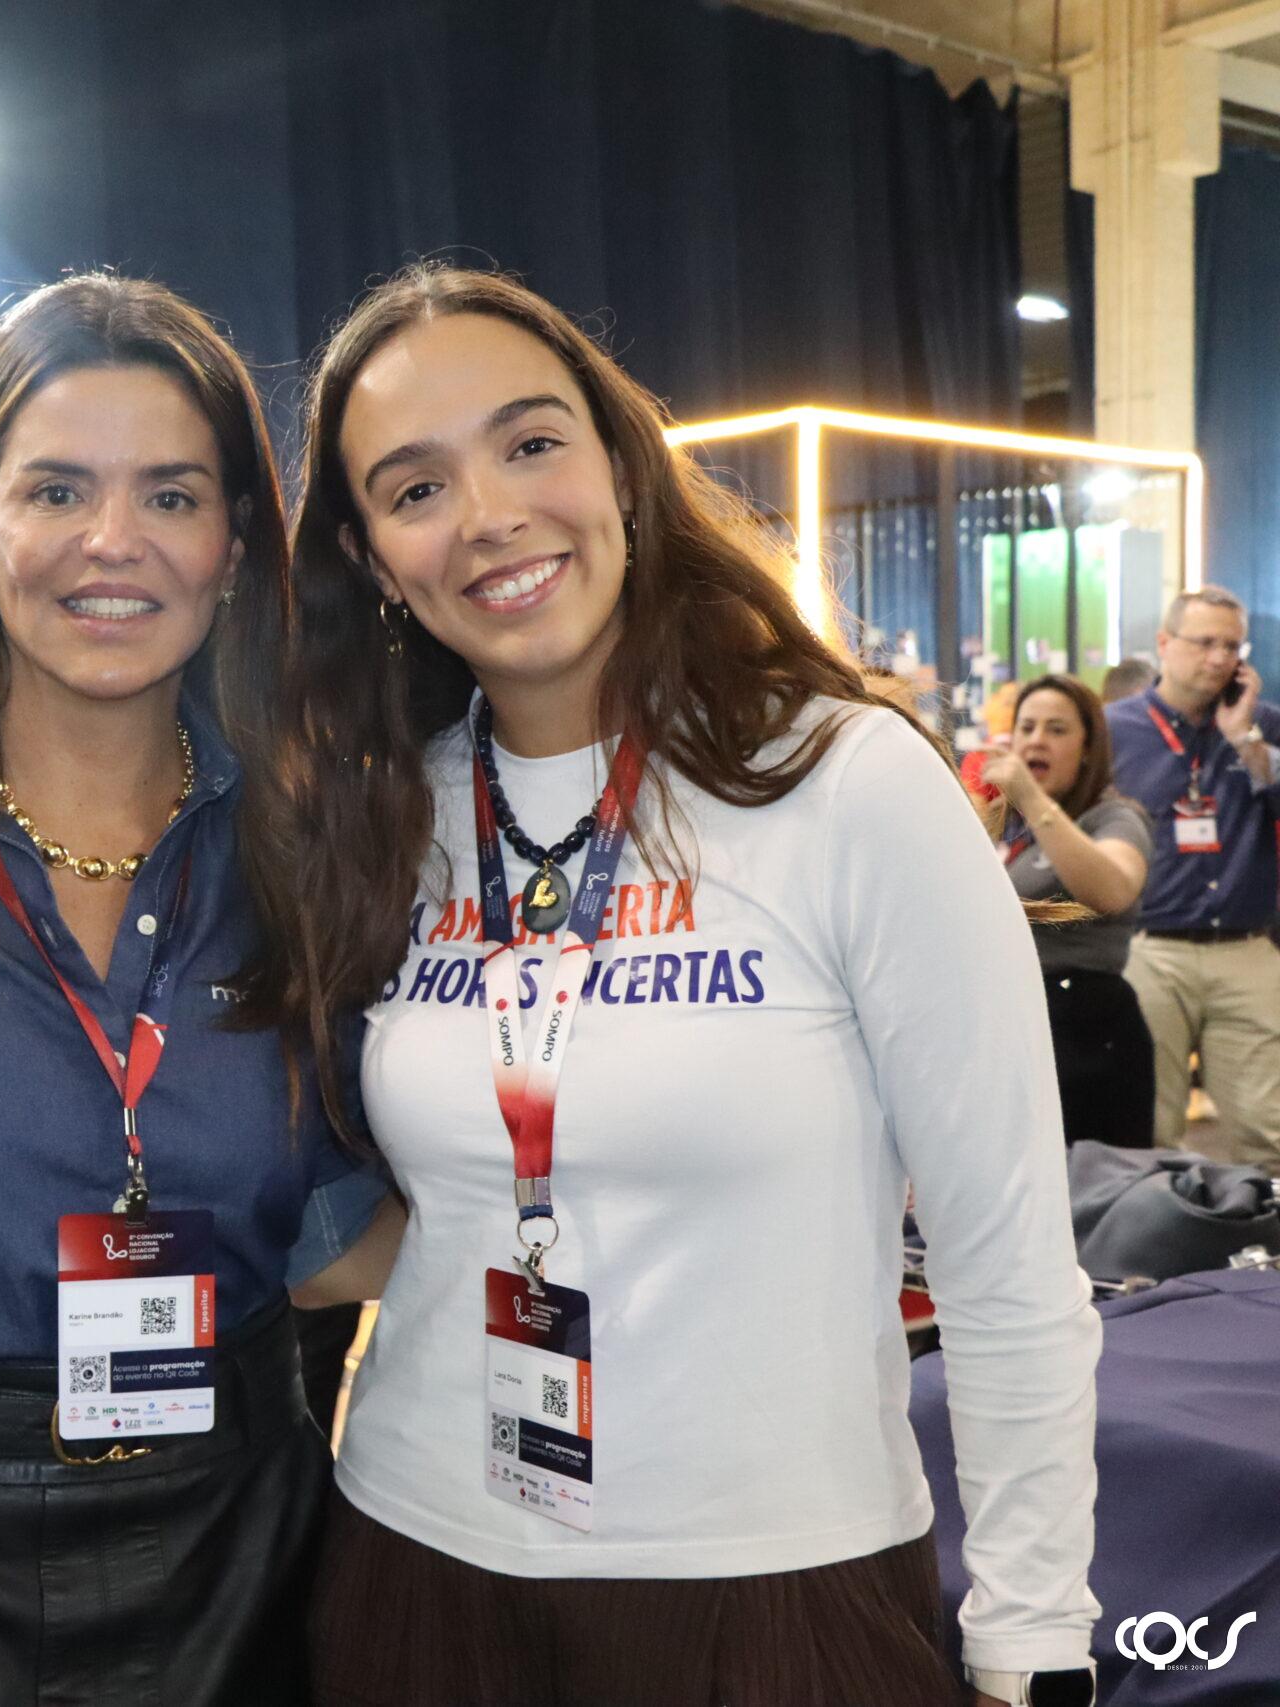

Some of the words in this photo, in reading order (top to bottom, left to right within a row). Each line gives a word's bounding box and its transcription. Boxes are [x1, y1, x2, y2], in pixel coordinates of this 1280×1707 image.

[596, 879, 696, 940] ERTA
[406, 957, 543, 1009] HORS
[580, 949, 765, 1006] NCERTAS
[498, 1016, 514, 1066] SOMPO
[542, 1009, 562, 1062] SOMPO
[200, 1288, 210, 1333] Expositor
[149, 1360, 206, 1372] programação
[178, 1369, 200, 1377] Code
